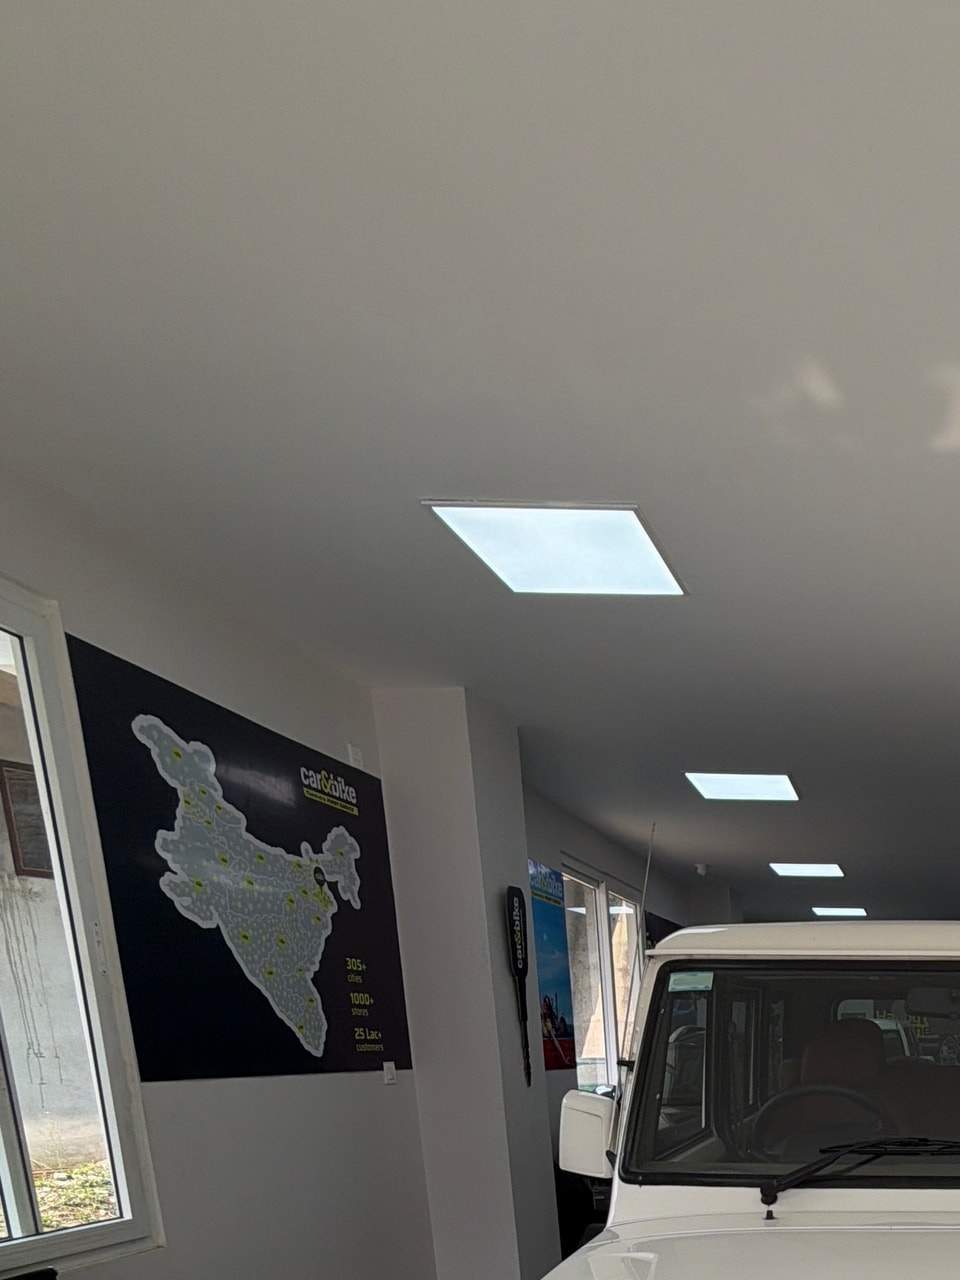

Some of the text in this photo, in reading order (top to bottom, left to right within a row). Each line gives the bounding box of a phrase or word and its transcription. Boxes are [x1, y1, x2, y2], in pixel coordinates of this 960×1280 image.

[300, 767, 357, 804] car&bike
[345, 957, 366, 971] 305+
[350, 992, 374, 1005] 1000+
[351, 1007, 369, 1016] stores
[354, 1027, 365, 1040] 25
[356, 1042, 384, 1052] customers
